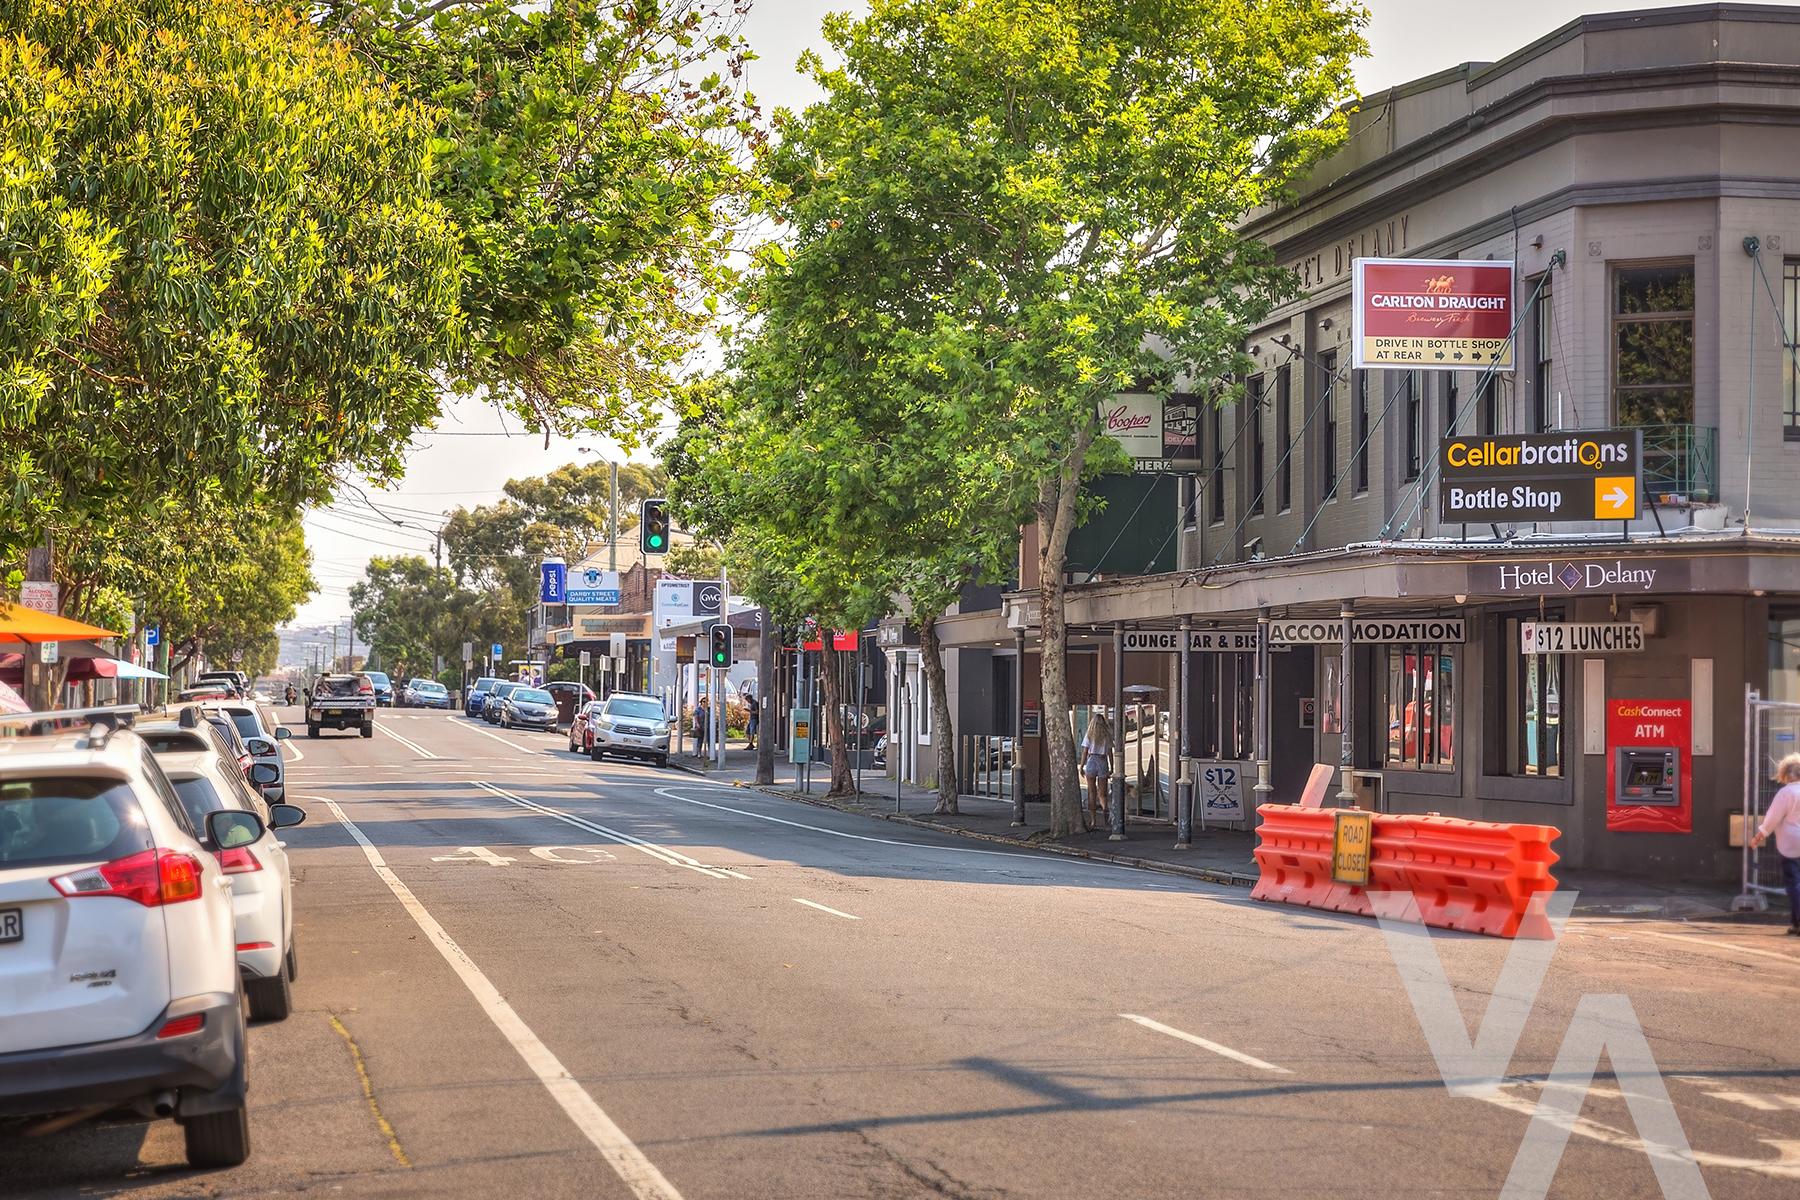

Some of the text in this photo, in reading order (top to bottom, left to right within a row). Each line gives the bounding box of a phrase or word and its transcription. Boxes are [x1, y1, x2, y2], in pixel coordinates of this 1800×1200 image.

[1371, 294, 1506, 310] CARLTON DRAUGHT
[1375, 339, 1501, 349] DRIVE IN BOTTLE SHOP
[1376, 351, 1422, 360] AT REAR
[1108, 405, 1152, 431] Coopers
[1133, 461, 1172, 471] HERE
[1450, 486, 1562, 513] Bottle Shop
[548, 570, 558, 597] pepsi
[1499, 561, 1657, 590] Hotel Delany
[1218, 635, 1229, 648] &
[1538, 625, 1642, 650] $12 LUNCHES
[1617, 706, 1682, 717] CashConnect
[1634, 724, 1665, 738] ATM
[1204, 768, 1236, 785] $12
[1342, 825, 1364, 843] ROAD
[1337, 852, 1367, 872] CLOSED
